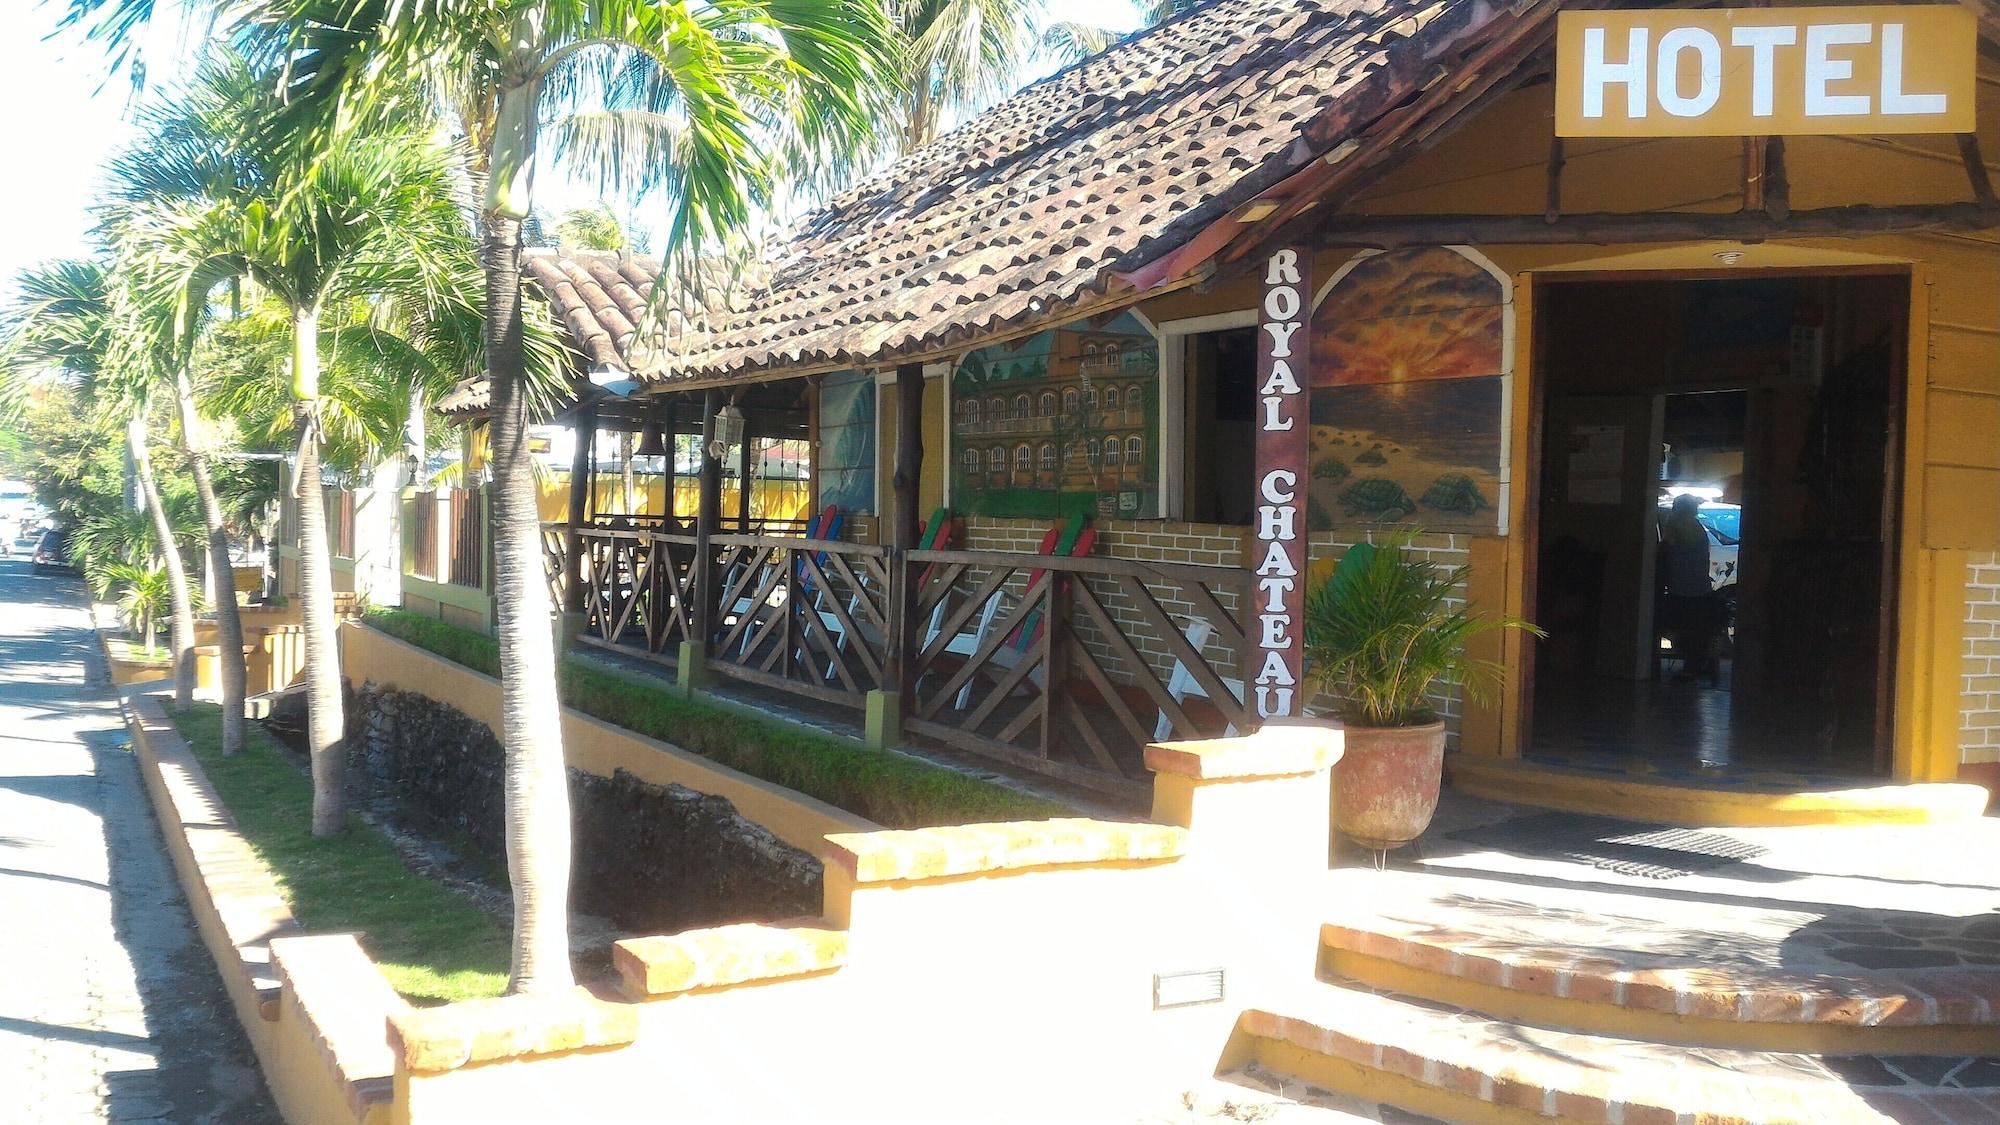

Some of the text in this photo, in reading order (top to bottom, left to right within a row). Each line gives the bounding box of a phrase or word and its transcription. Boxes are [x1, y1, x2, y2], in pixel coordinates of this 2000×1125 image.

[1583, 23, 1947, 118] HOTEL
[1255, 249, 1302, 719] ROYAL CHATEAU
